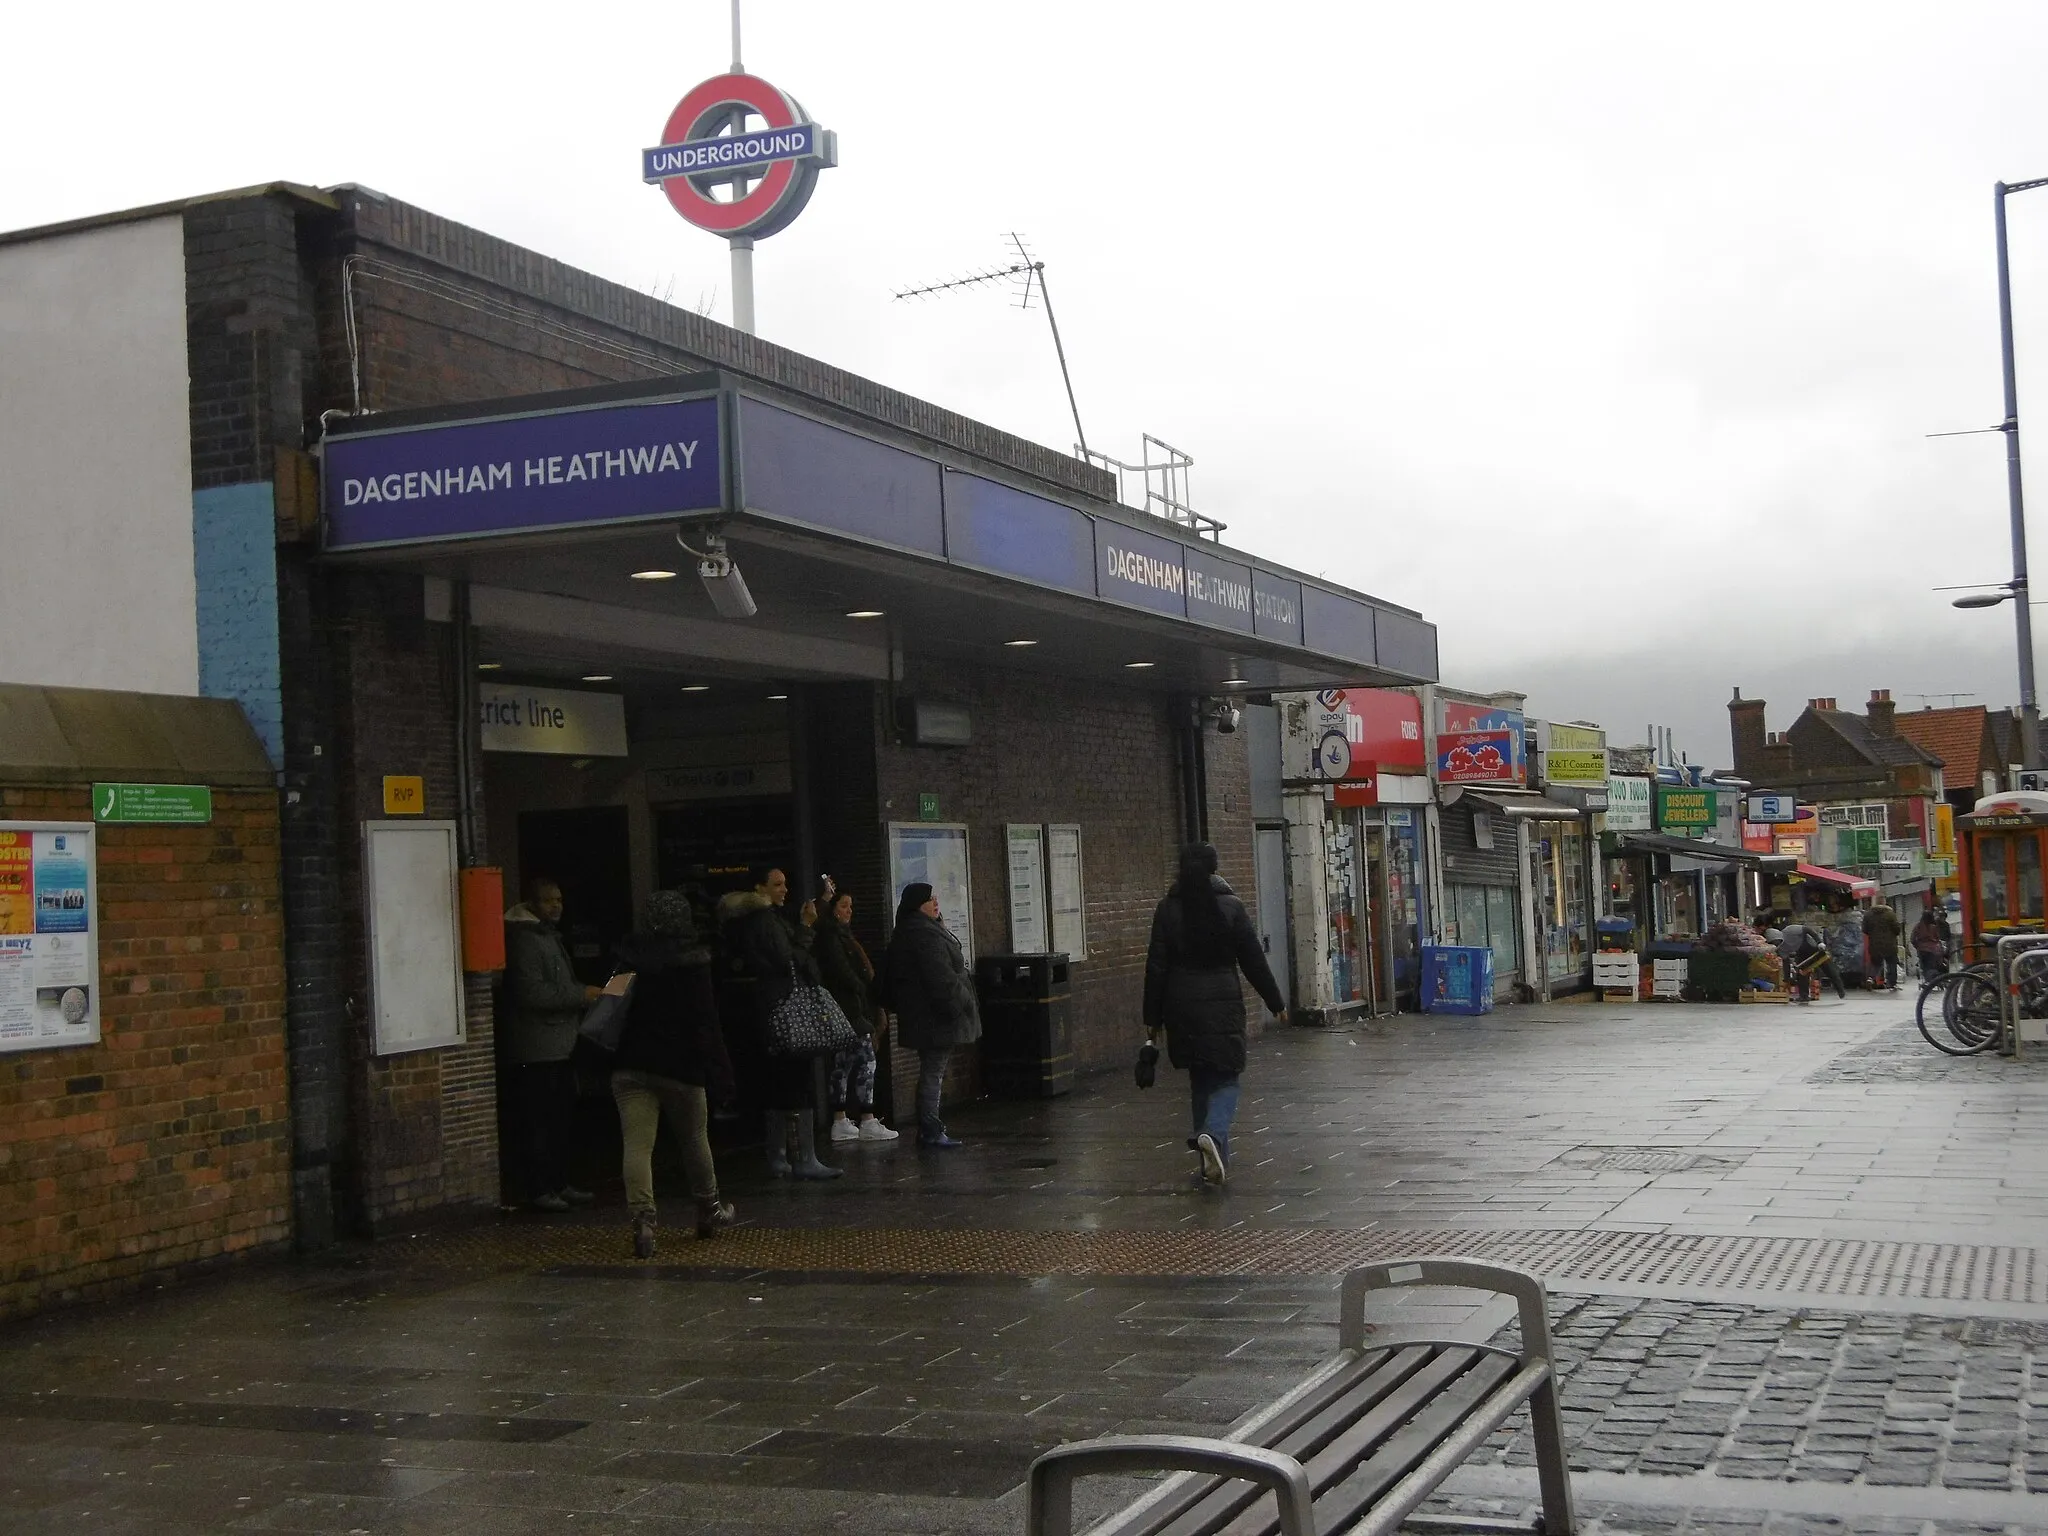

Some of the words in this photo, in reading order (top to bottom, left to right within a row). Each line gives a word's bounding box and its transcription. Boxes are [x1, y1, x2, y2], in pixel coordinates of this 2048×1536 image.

[652, 132, 806, 172] UNDERGROUND
[343, 461, 512, 506] DAGENHAM
[524, 440, 699, 487] HEATHWAY
[1107, 545, 1184, 595] DAGENHAM
[1187, 569, 1250, 613] HEATHWAY
[1254, 589, 1296, 625] STATION
[528, 698, 565, 729] line
[1320, 712, 1344, 723] epay
[1401, 720, 1418, 740] FOXES
[1569, 759, 1605, 769] Cosmetic
[393, 788, 414, 801] RVP
[1666, 794, 1706, 808] DISCOUNT
[1664, 808, 1709, 822] JEWELLERS
[1999, 816, 2020, 826] here
